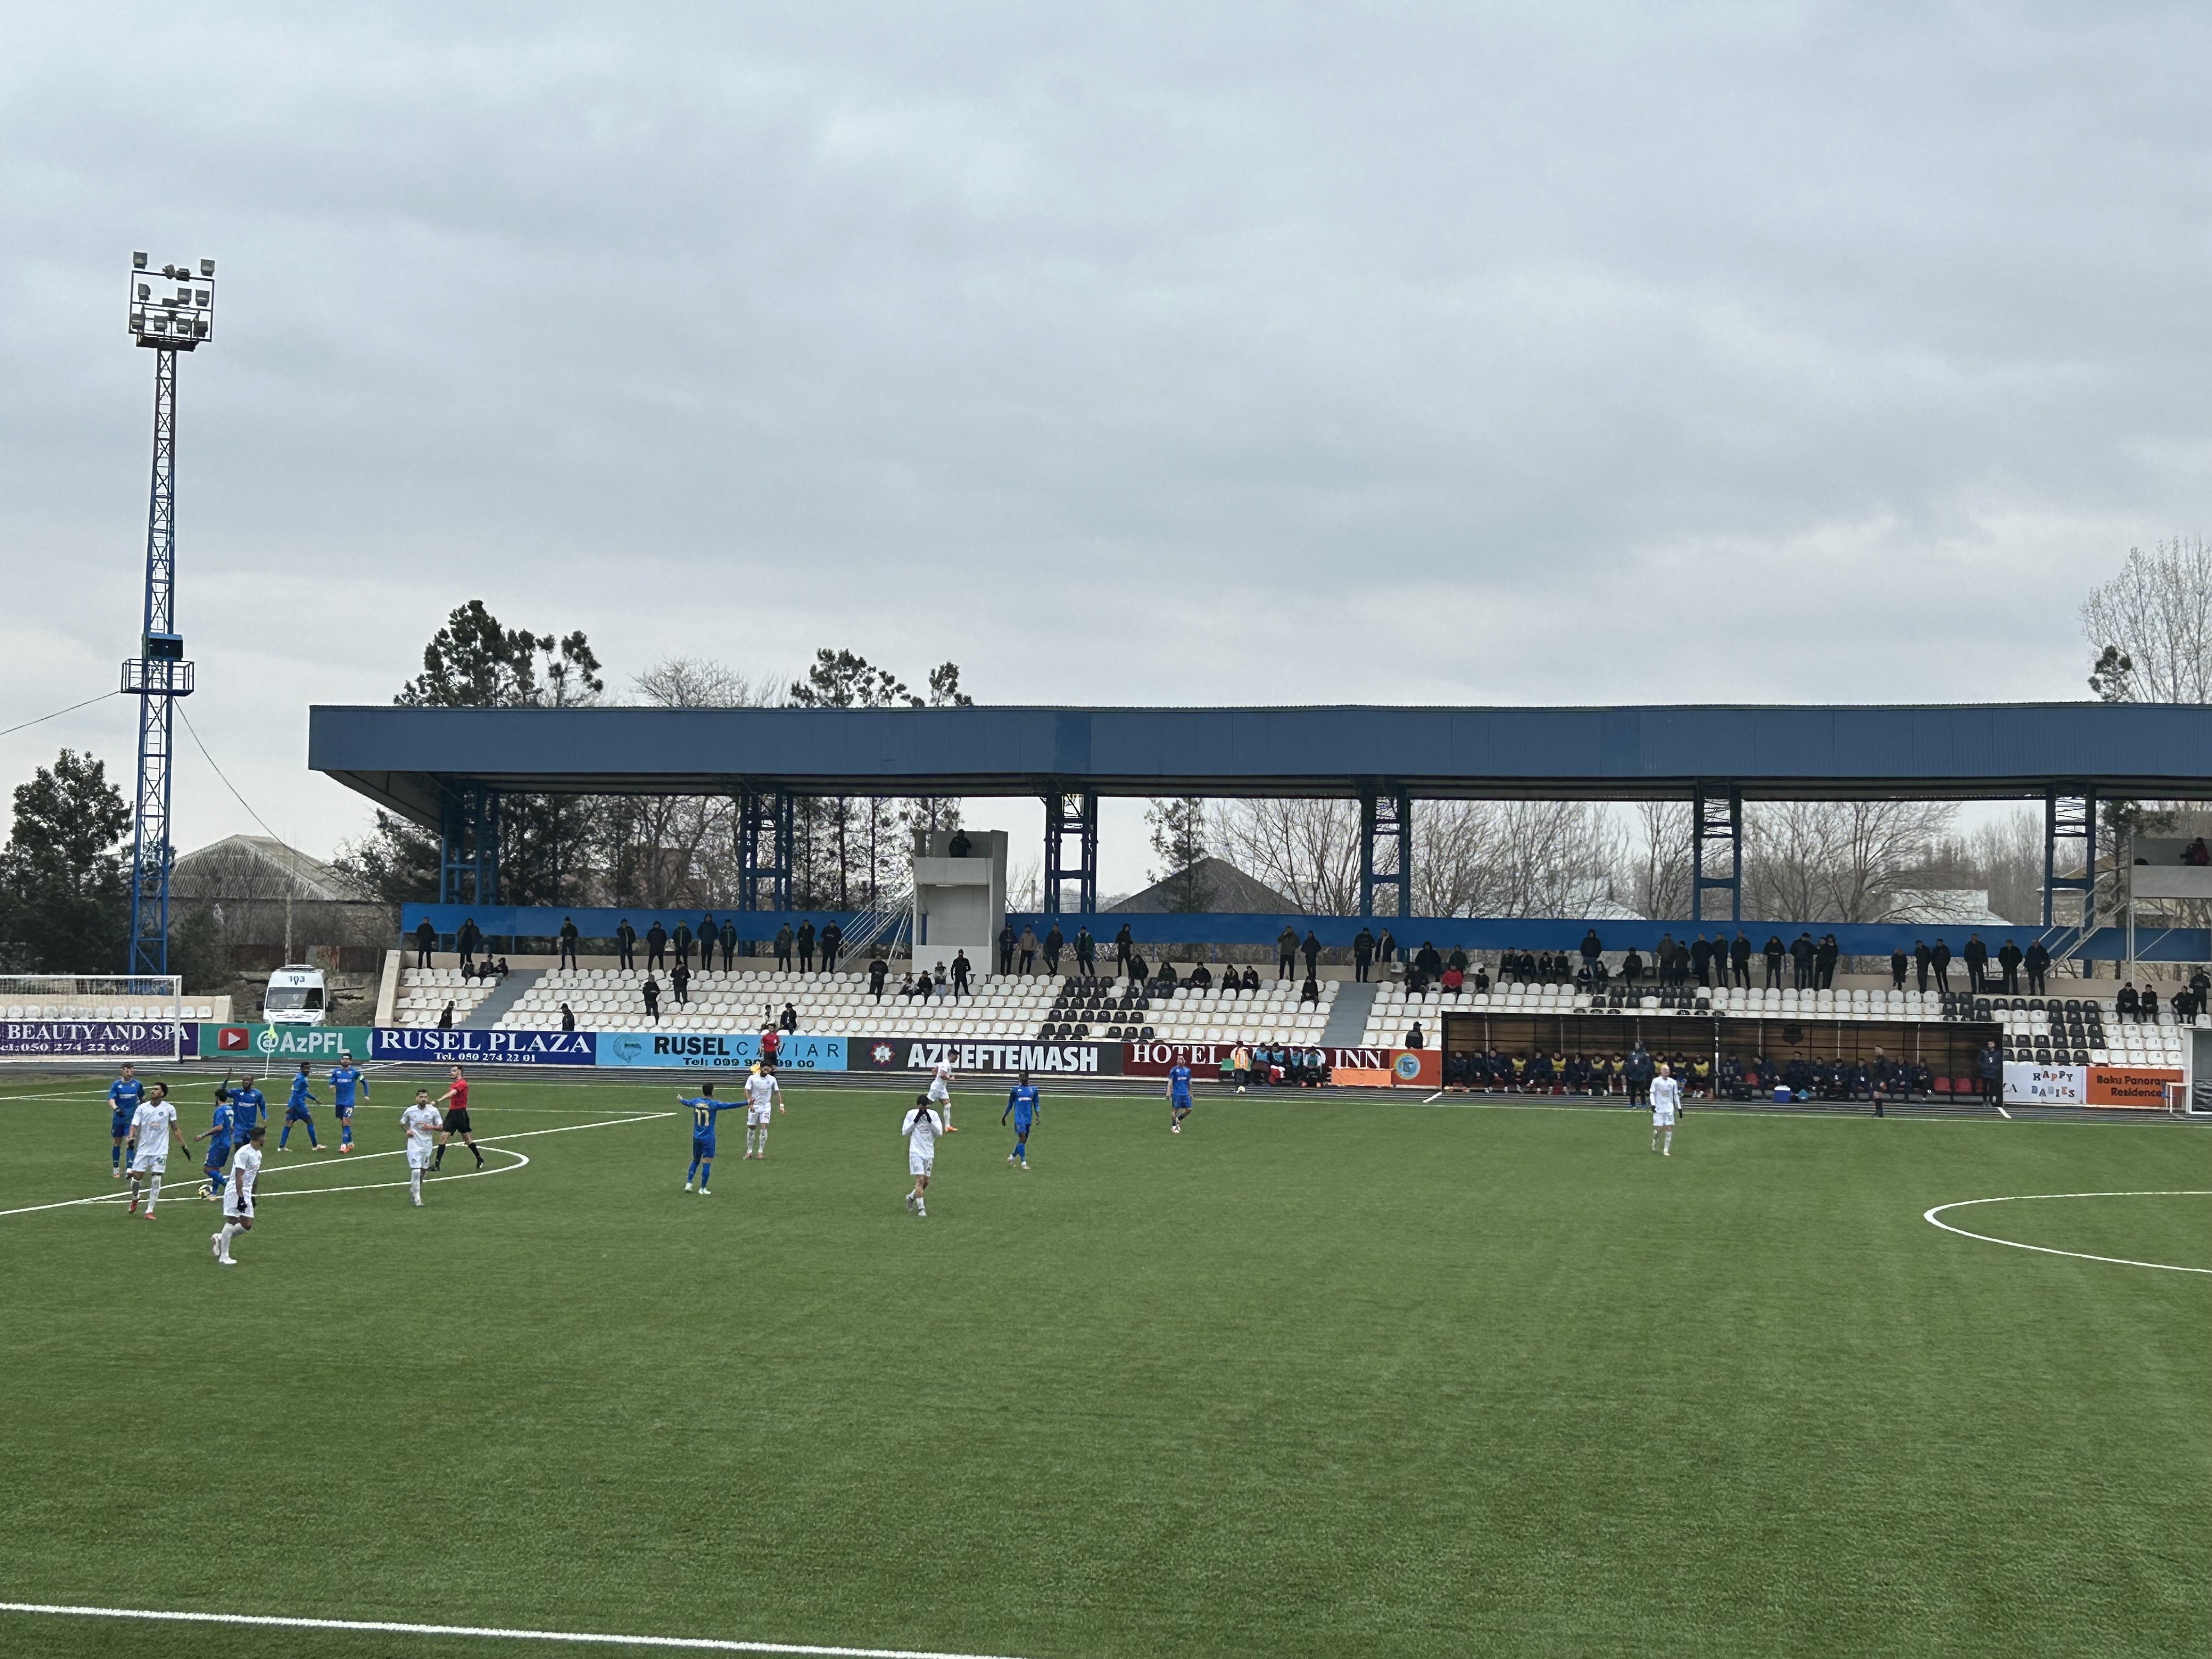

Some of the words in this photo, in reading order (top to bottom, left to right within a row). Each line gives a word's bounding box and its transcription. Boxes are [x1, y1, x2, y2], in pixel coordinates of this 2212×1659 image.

[7, 1024, 96, 1041] BEAUTY
[99, 1024, 146, 1041] AND
[150, 1025, 189, 1041] SPA
[257, 1030, 350, 1054] @AzPFL
[380, 1030, 481, 1051] RUSEL
[488, 1032, 592, 1053] PLAZA
[654, 1036, 730, 1056] RUSEL
[1132, 1044, 1222, 1064] HOTEL
[1334, 1049, 1381, 1069] INN
[507, 1053, 520, 1062] 22
[907, 1043, 1098, 1072] AZNEFTEMASH
[2096, 1075, 2122, 1084] Baku
